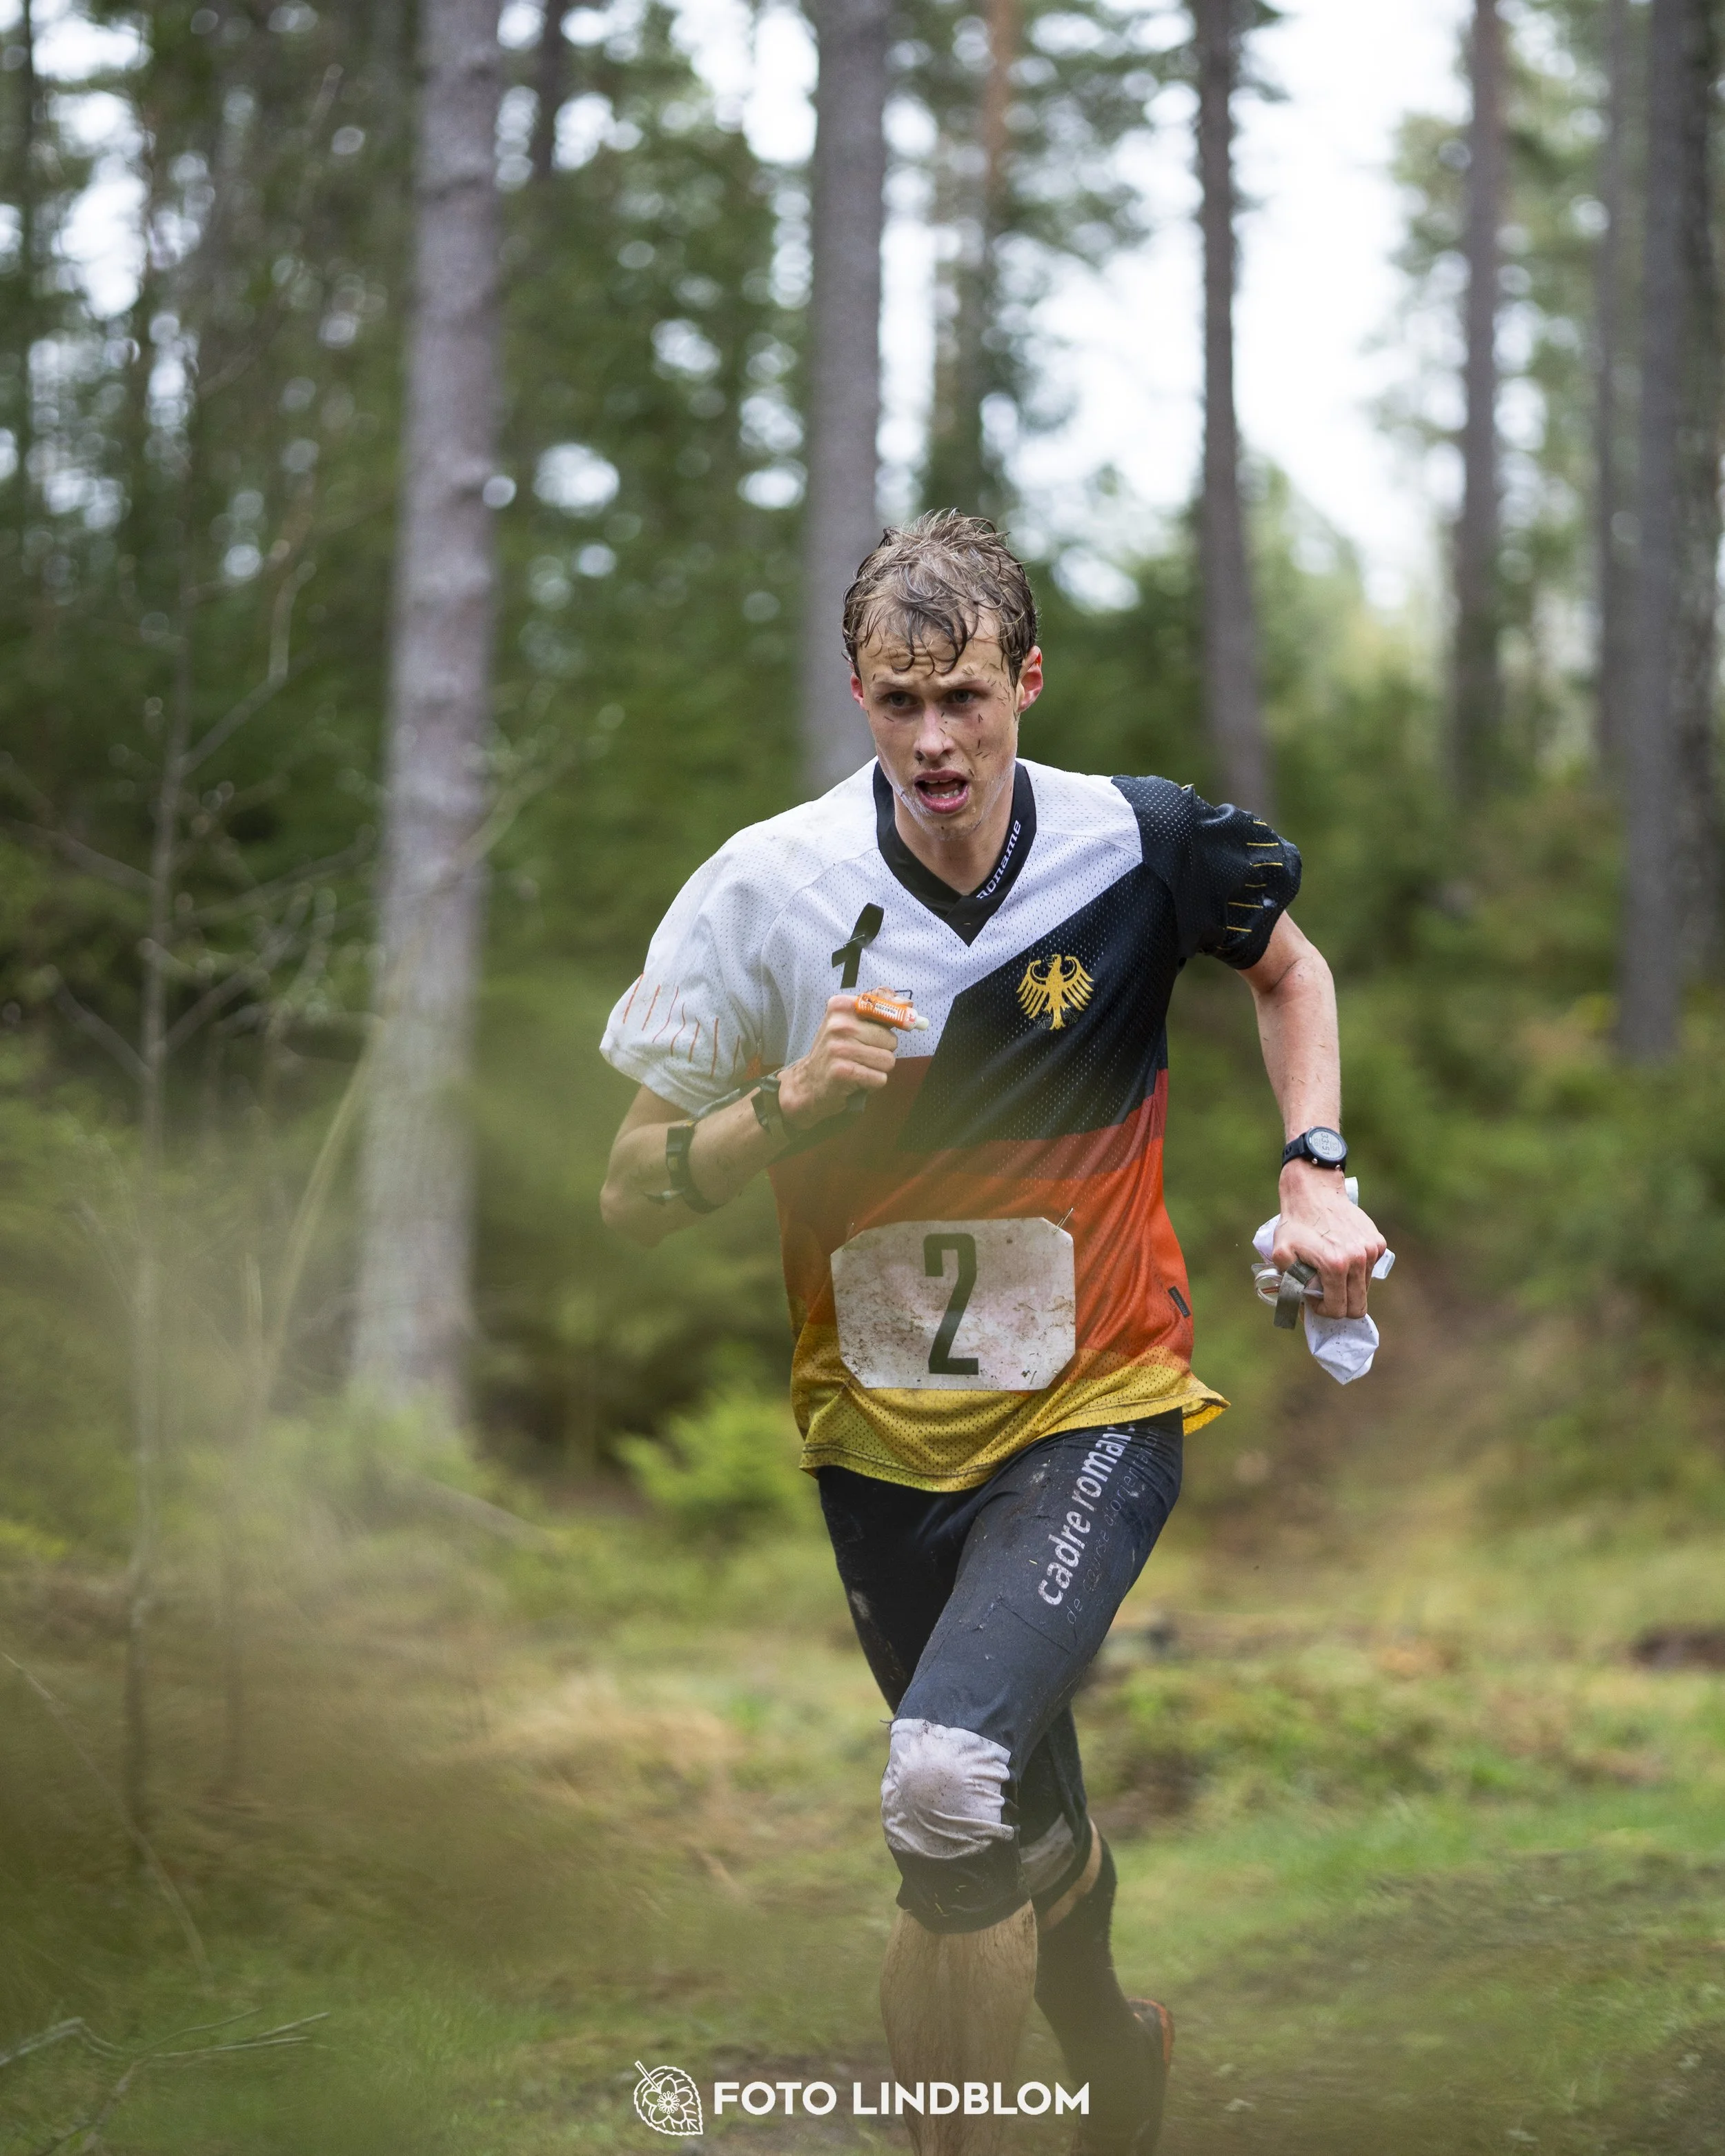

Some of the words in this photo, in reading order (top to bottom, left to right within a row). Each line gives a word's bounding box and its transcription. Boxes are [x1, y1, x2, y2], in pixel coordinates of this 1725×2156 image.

[976, 820, 1021, 900] noname
[923, 1233, 978, 1375] 2
[1038, 1511, 1090, 1605] cadre
[1067, 1599, 1083, 1624] de
